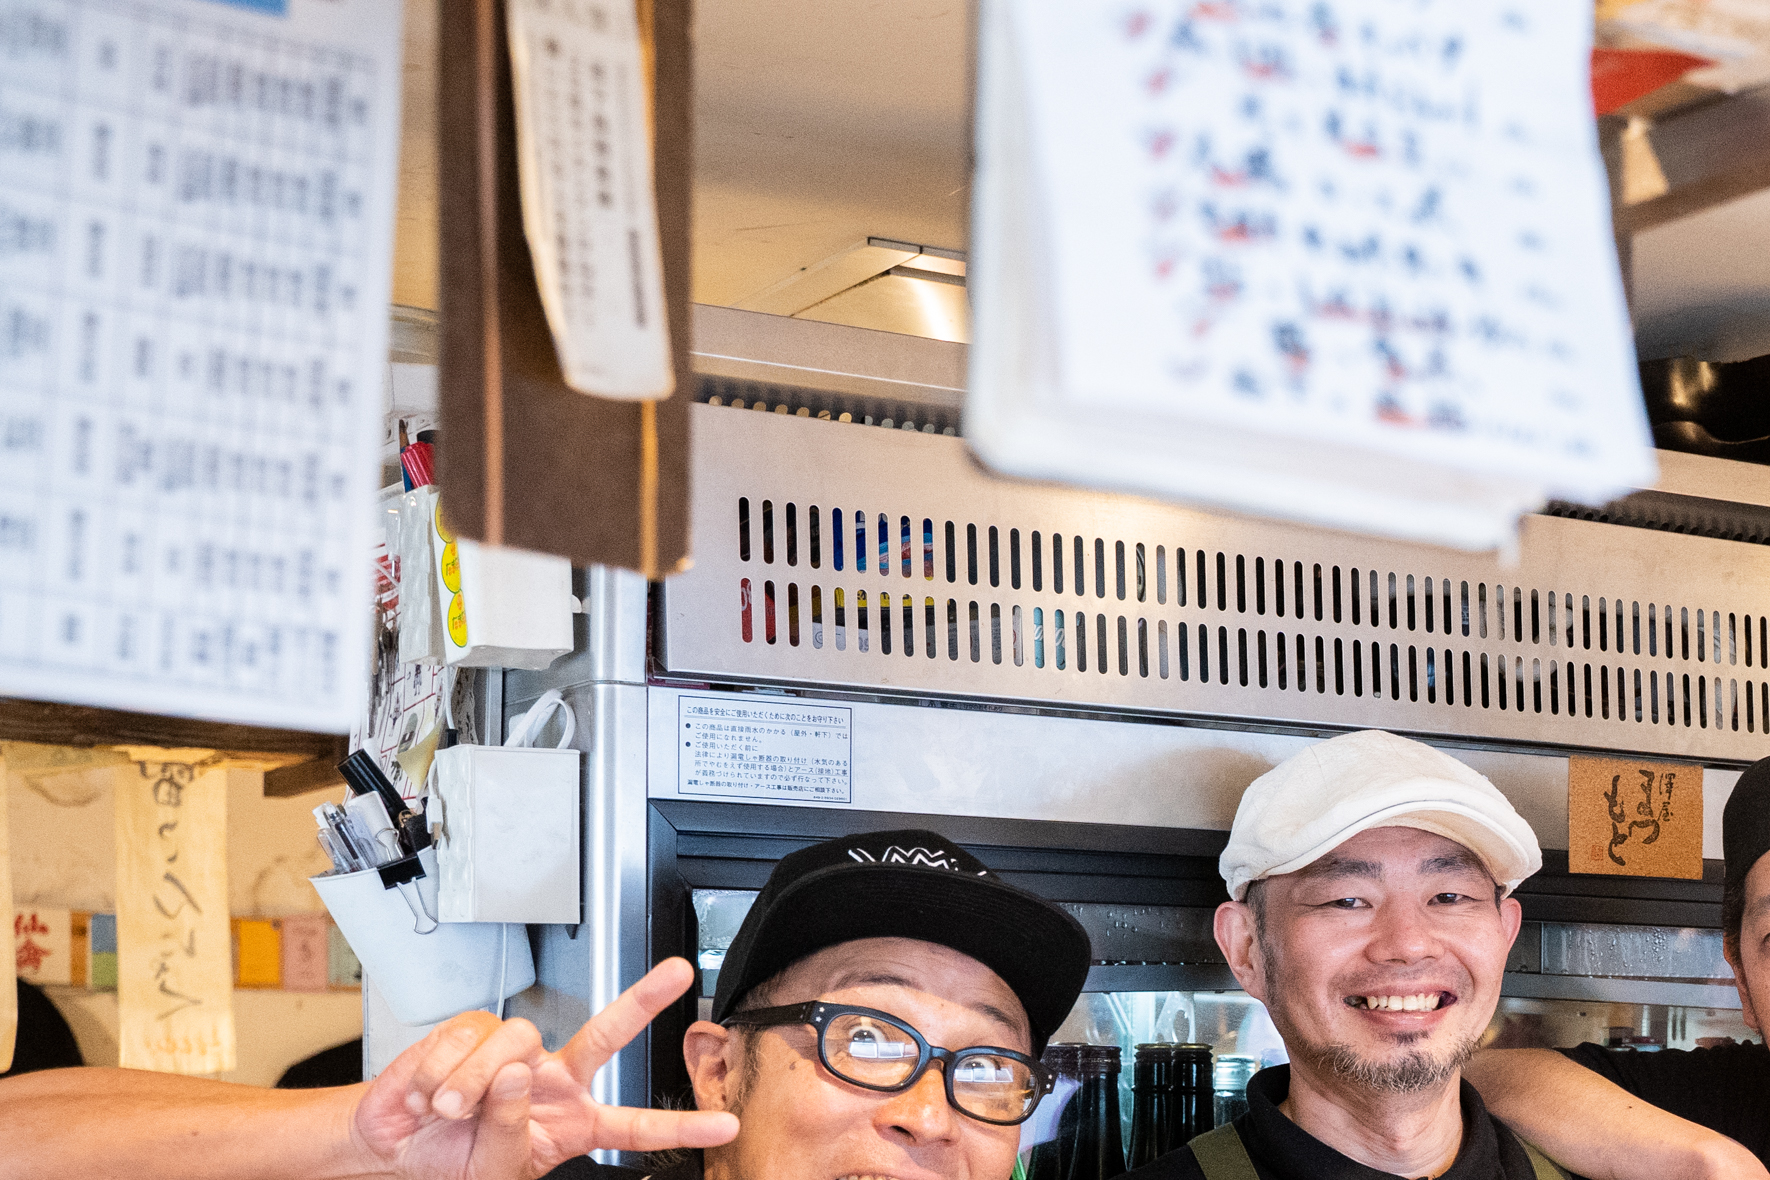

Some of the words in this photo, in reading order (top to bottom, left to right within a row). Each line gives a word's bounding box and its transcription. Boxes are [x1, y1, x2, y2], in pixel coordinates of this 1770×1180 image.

[686, 705, 844, 724] この商品を安全にご使用いただくために次のことをお守り下さい
[694, 732, 763, 744] ご使用になれません。
[694, 741, 758, 752] ご使用いただく前に
